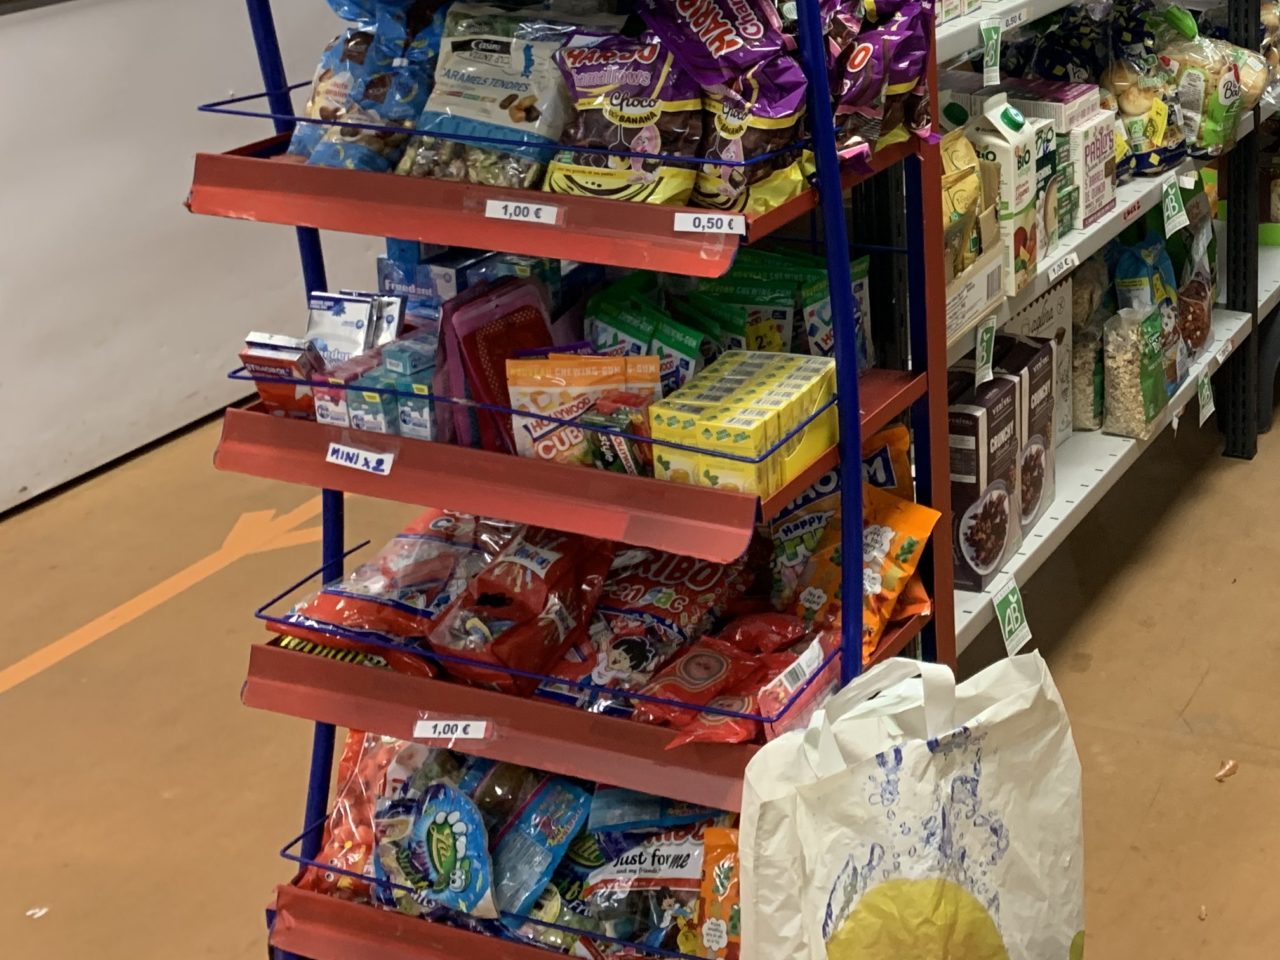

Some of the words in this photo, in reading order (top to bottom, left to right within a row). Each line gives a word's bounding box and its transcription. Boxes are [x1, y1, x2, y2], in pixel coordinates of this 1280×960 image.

[443, 69, 490, 87] ARAMELS
[490, 77, 532, 93] TENDRES
[609, 91, 659, 110] Choco
[618, 110, 657, 125] BANANA
[502, 204, 531, 218] 1,00
[533, 207, 542, 219] €
[692, 216, 723, 230] 0,50
[727, 218, 734, 230] €
[331, 448, 361, 465] MINI
[638, 553, 724, 590] RIBO
[1004, 600, 1022, 640] AB
[432, 724, 459, 737] 1,00
[462, 724, 470, 735] €
[612, 850, 648, 868] Just
